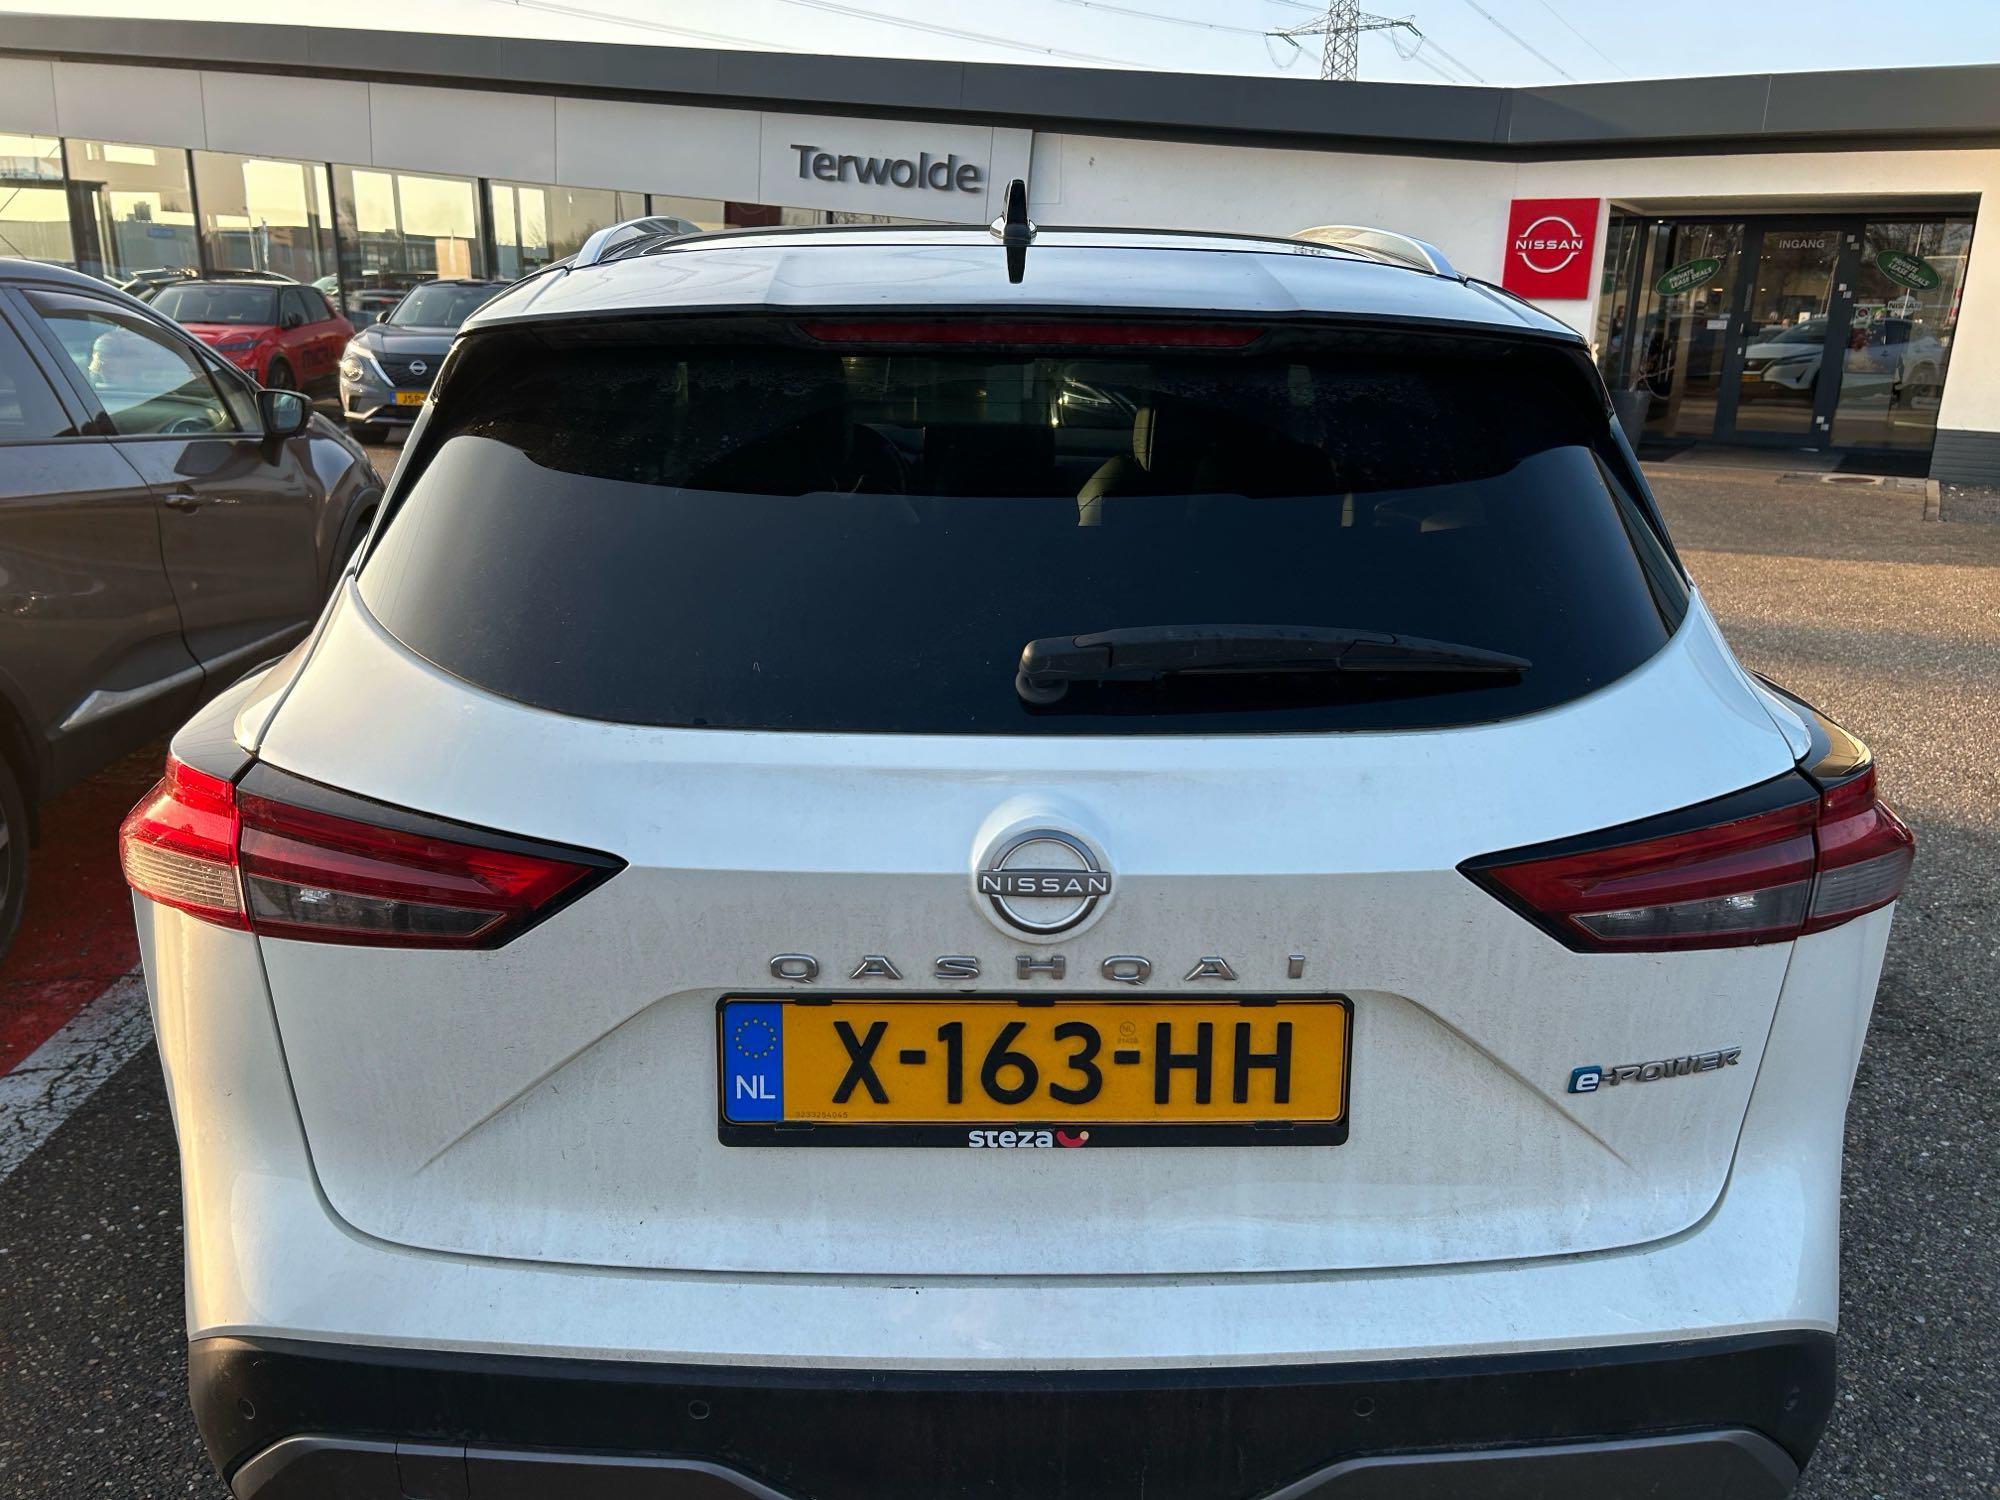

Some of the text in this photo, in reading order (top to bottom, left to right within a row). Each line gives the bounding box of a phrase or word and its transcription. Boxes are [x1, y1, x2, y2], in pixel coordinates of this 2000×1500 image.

[790, 144, 982, 193] Terwolde
[1515, 240, 1583, 249] NISSAN
[1779, 239, 1825, 248] INGANG
[1888, 263, 1909, 275] LEASE
[1908, 272, 1930, 287] DEALS
[1892, 257, 1919, 273] PRIVATE
[1669, 268, 1694, 284] PRIVATE
[1671, 276, 1690, 288] LEASE
[1691, 267, 1712, 280] DEALS
[982, 875, 1107, 892] NISSAN
[770, 954, 1306, 985] QASHQAI
[832, 1021, 1292, 1104] X-163-HH
[1570, 1046, 1742, 1092] e-POWER
[736, 1074, 776, 1100] NL
[968, 1127, 1053, 1148] steza
